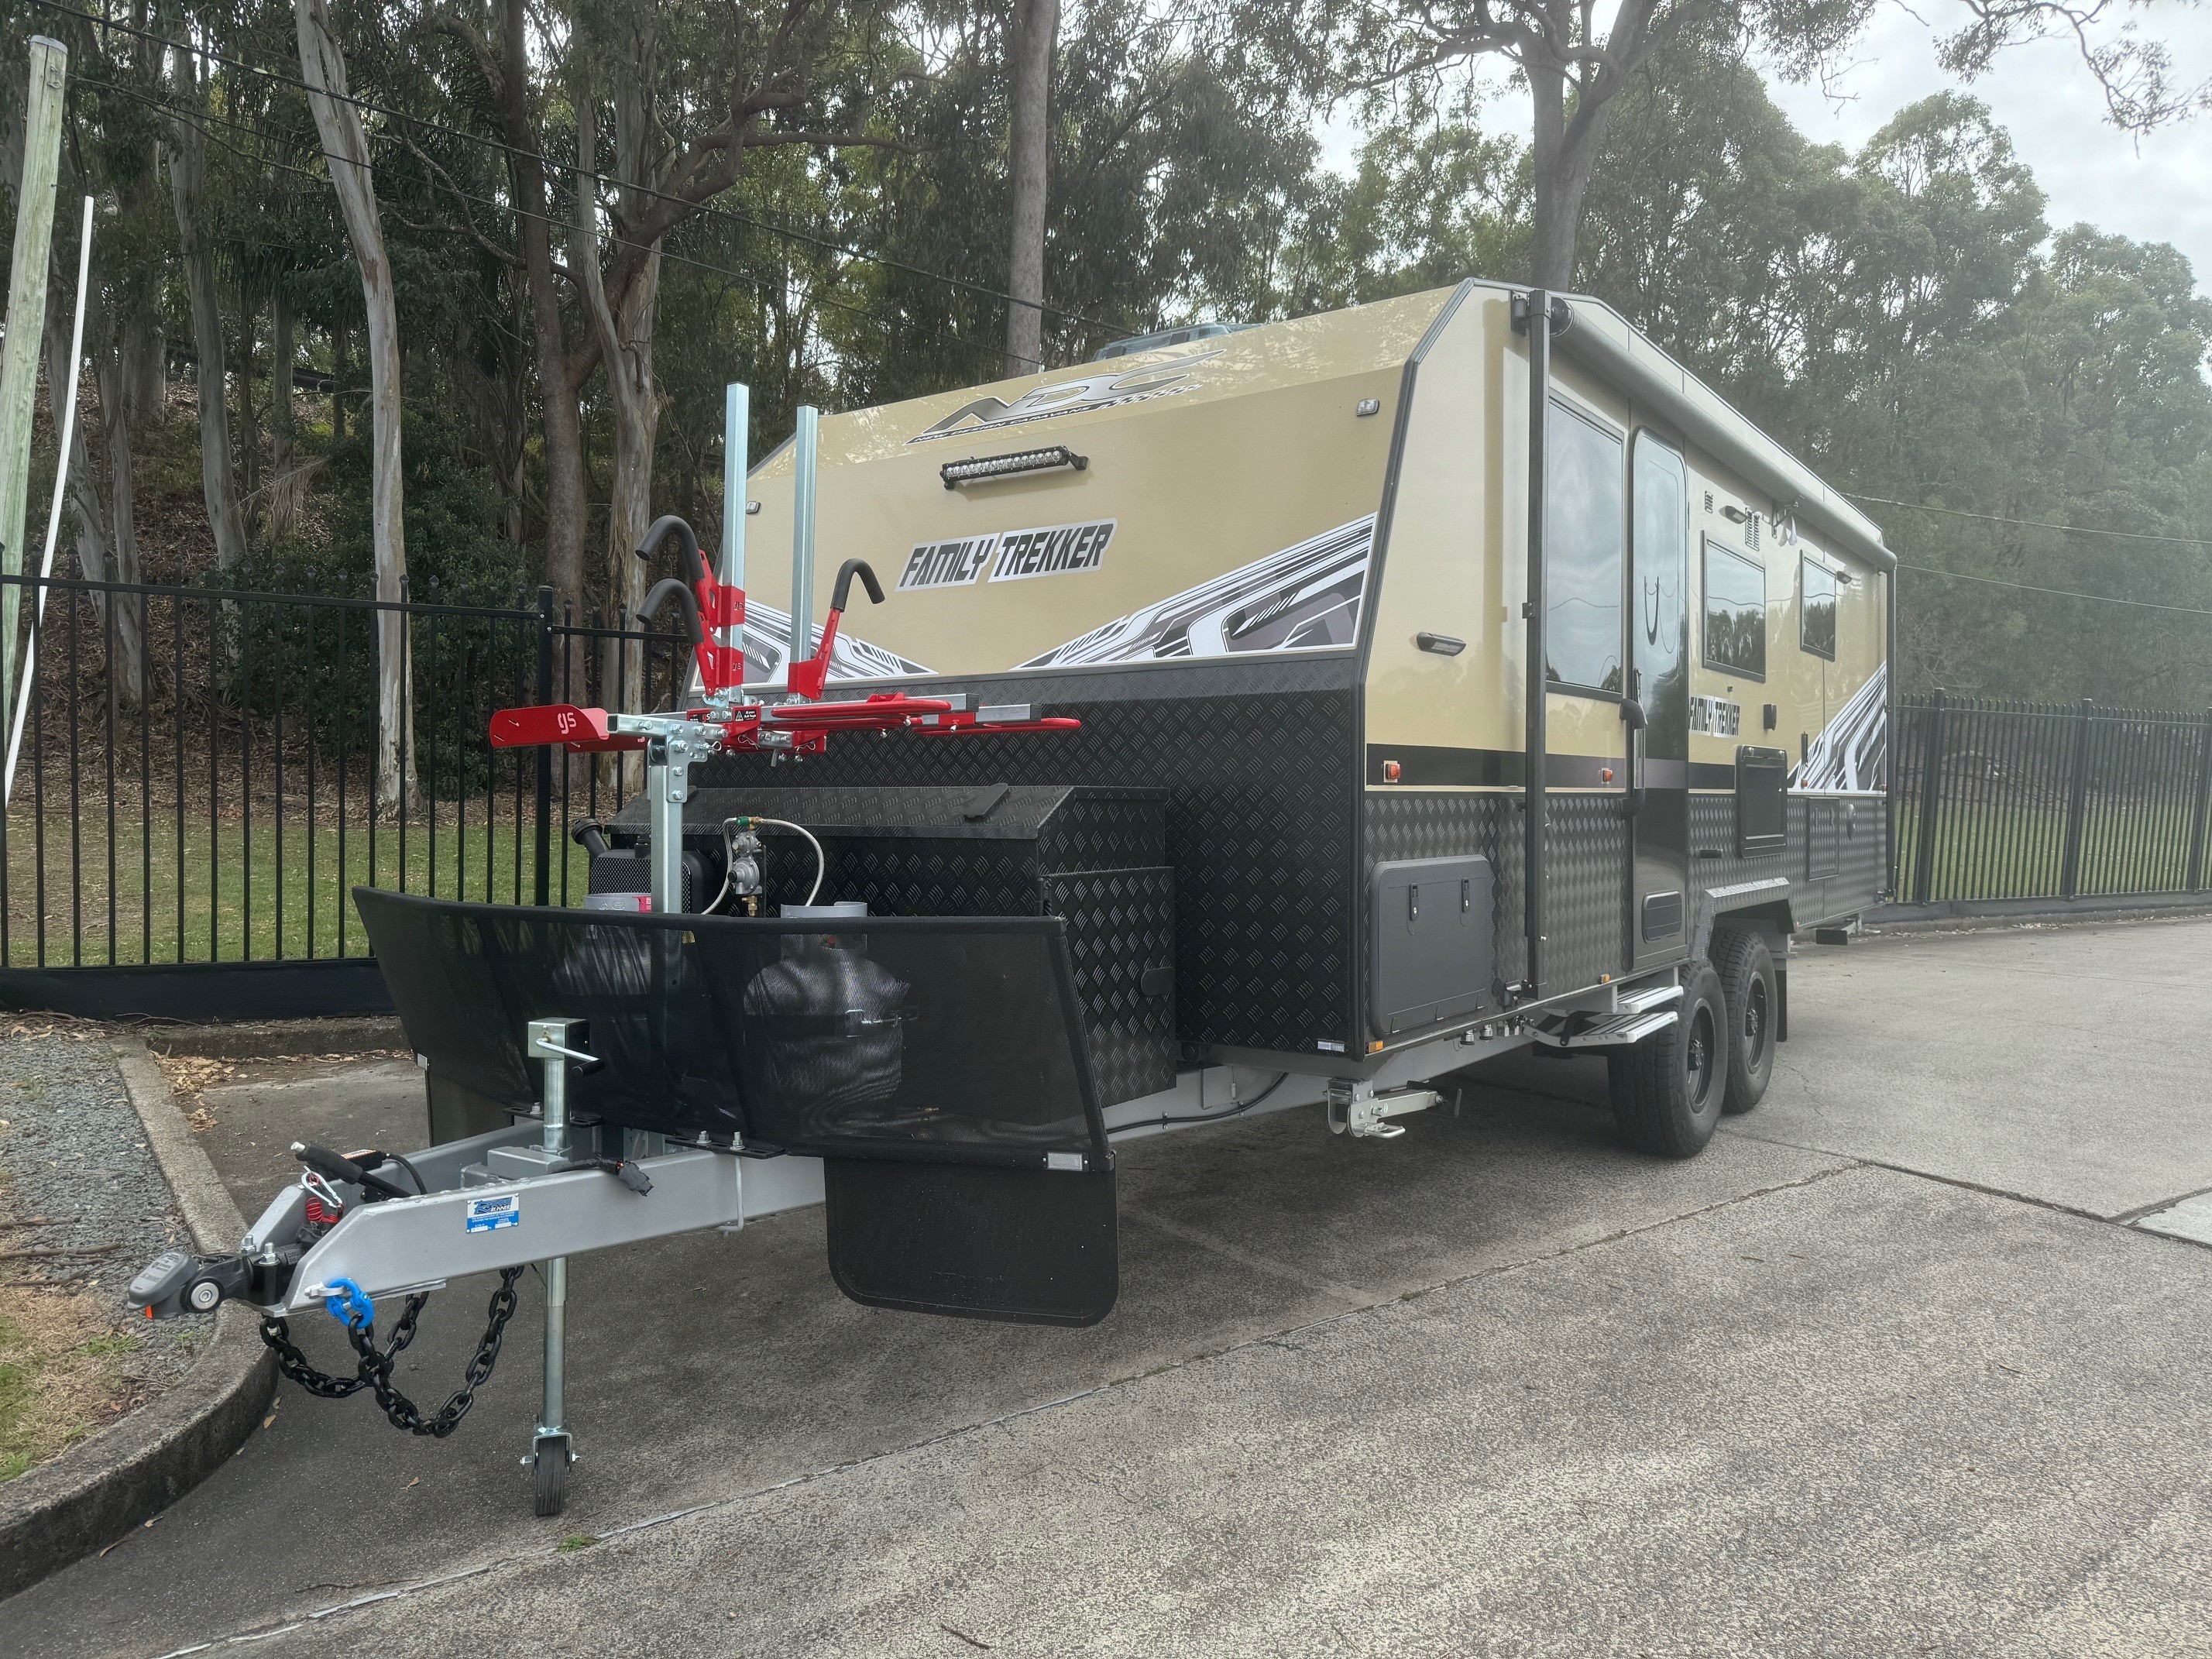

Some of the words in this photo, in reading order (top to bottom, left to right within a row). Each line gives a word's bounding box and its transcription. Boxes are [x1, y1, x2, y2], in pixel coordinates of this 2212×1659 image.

[914, 433, 949, 442] NEW
[951, 422, 1006, 435] DESIGN
[1010, 406, 1092, 424] CARAVANS
[898, 538, 995, 588] FAMILY
[993, 523, 1115, 578] TREKKER
[557, 712, 577, 735] gs
[1688, 697, 1712, 732] FAMILY
[1715, 701, 1740, 736] TREKKER
